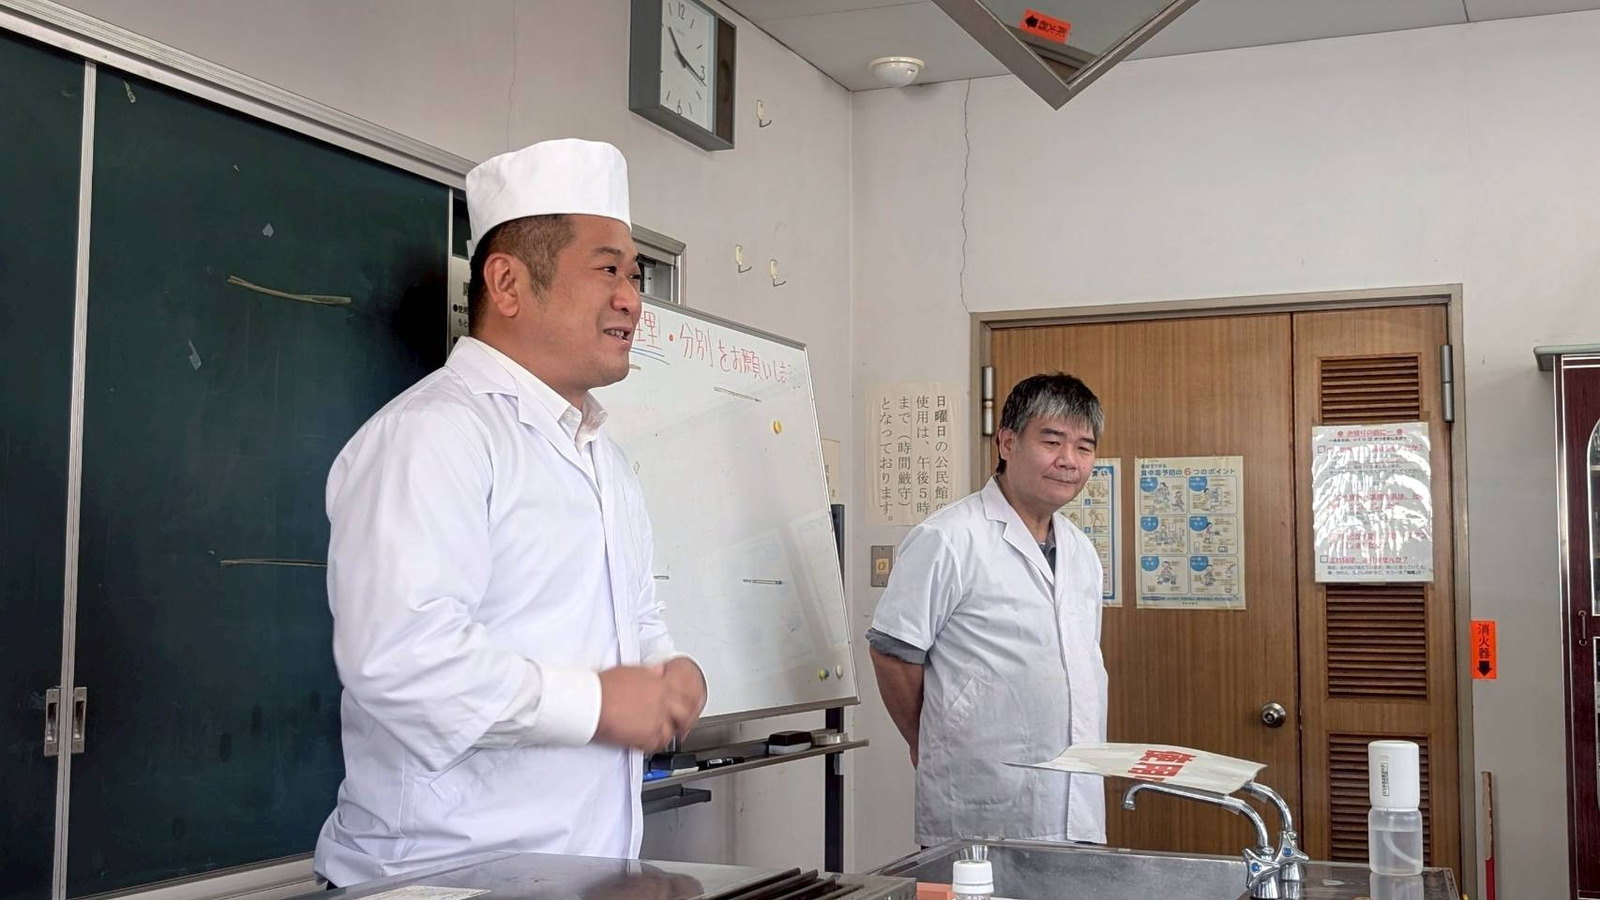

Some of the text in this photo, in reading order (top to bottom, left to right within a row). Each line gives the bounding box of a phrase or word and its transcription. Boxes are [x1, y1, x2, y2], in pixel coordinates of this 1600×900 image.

[678, 2, 686, 20] 12
[880, 397, 893, 521] となっております。
[1478, 622, 1490, 659] 消火器
